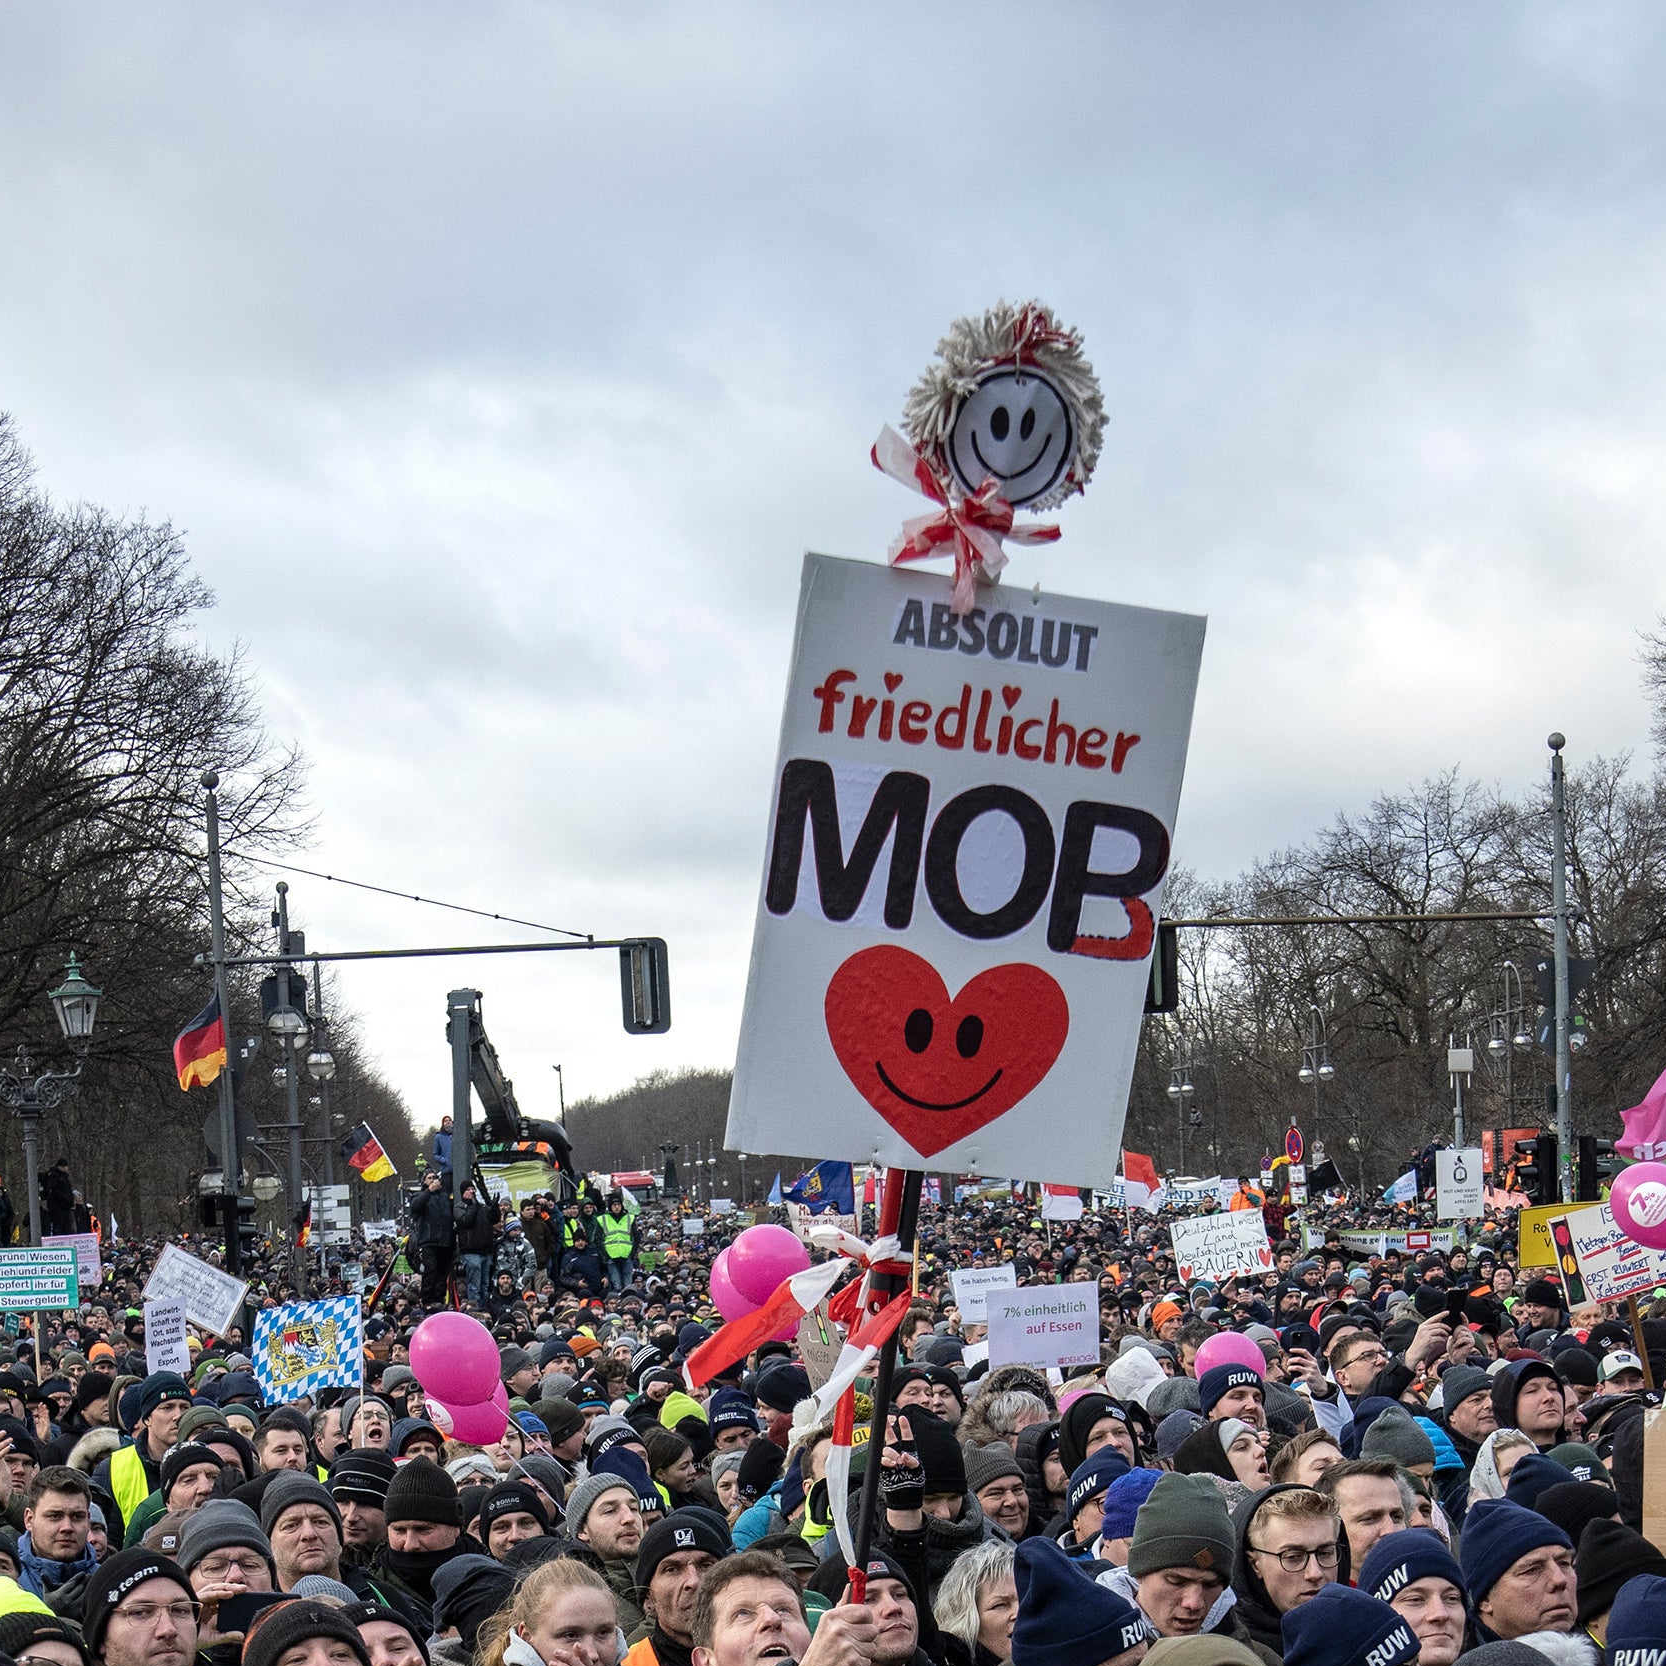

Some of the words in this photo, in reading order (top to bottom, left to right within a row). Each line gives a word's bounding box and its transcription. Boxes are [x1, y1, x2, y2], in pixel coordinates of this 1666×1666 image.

[893, 598, 1100, 673] ABSOLUT
[813, 668, 1142, 776] friedlicher
[765, 758, 1171, 962] MOB
[1196, 1187, 1220, 1199] IST
[1173, 1217, 1237, 1243] Deutschland
[1238, 1216, 1263, 1228] mein
[1203, 1232, 1238, 1247] Land
[1391, 1235, 1406, 1244] nur
[1430, 1233, 1450, 1243] Wolf
[29, 1252, 71, 1263] Wiesen,
[1176, 1243, 1239, 1264] Deutschland
[1239, 1239, 1267, 1251] meine
[1192, 1250, 1261, 1278] BAUERN
[18, 1266, 38, 1277] und
[40, 1265, 74, 1276] Felder
[34, 1279, 48, 1290] ihr
[50, 1278, 67, 1290] für
[991, 1276, 1009, 1286] fertig.
[1596, 1273, 1653, 1299] Lebensmittel
[0, 1295, 69, 1308] Steuergelder
[150, 1306, 182, 1318] Landwirt-
[1002, 1305, 1022, 1319] 7%
[1024, 1300, 1088, 1317] einheitlich
[150, 1317, 171, 1328] schaft
[172, 1316, 183, 1325] vor
[1026, 1322, 1047, 1336] auf
[1049, 1319, 1083, 1334] Essen
[153, 1327, 165, 1338] Ort,
[165, 1326, 180, 1337] statt
[150, 1337, 183, 1349] Wachstum
[161, 1348, 174, 1356] und
[157, 1356, 181, 1368] Export
[1063, 1353, 1098, 1365] DEHOGA
[1227, 1372, 1258, 1387] RUW
[1072, 1473, 1098, 1506] RUW
[496, 1496, 521, 1506] BOMAG
[118, 1565, 159, 1592] team
